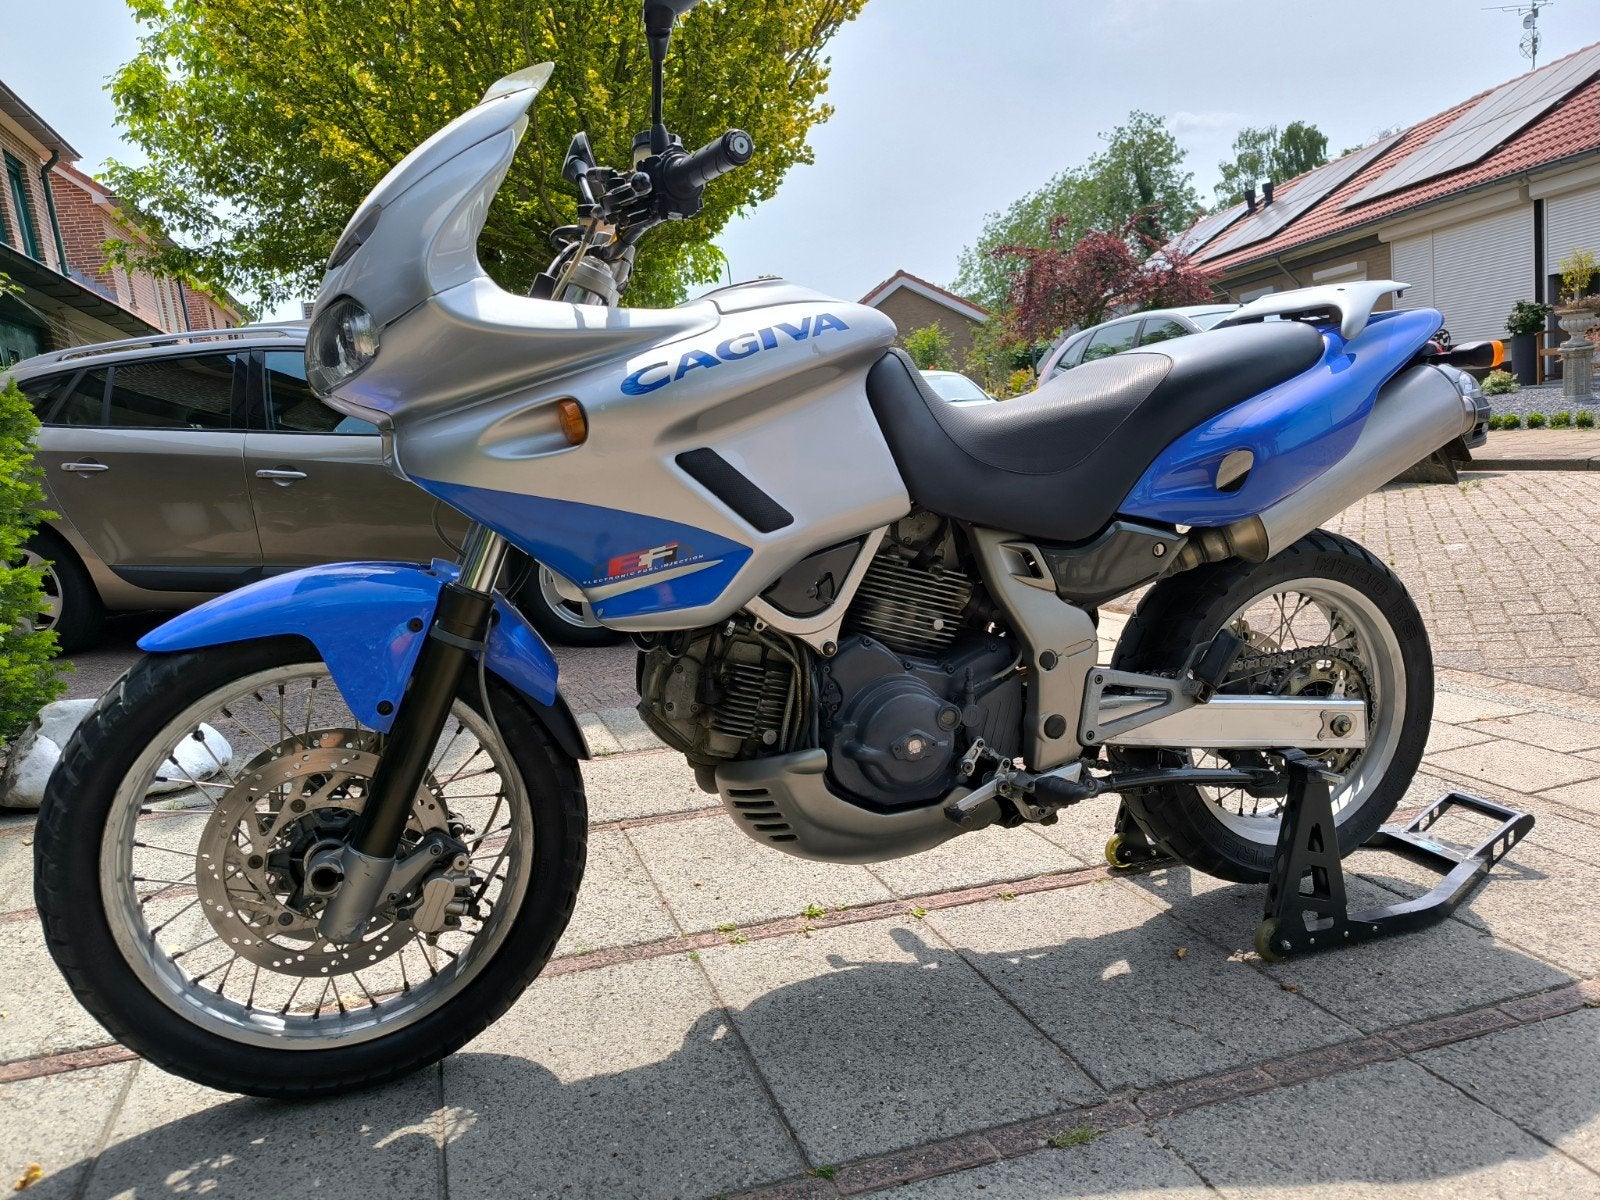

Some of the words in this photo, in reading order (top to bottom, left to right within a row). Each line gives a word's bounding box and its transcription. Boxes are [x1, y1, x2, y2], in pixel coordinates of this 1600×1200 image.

[620, 313, 850, 396] CAGIVA
[582, 571, 635, 585] ELECTRONIC
[637, 566, 659, 575] FUEL
[660, 554, 704, 569] INJECTION
